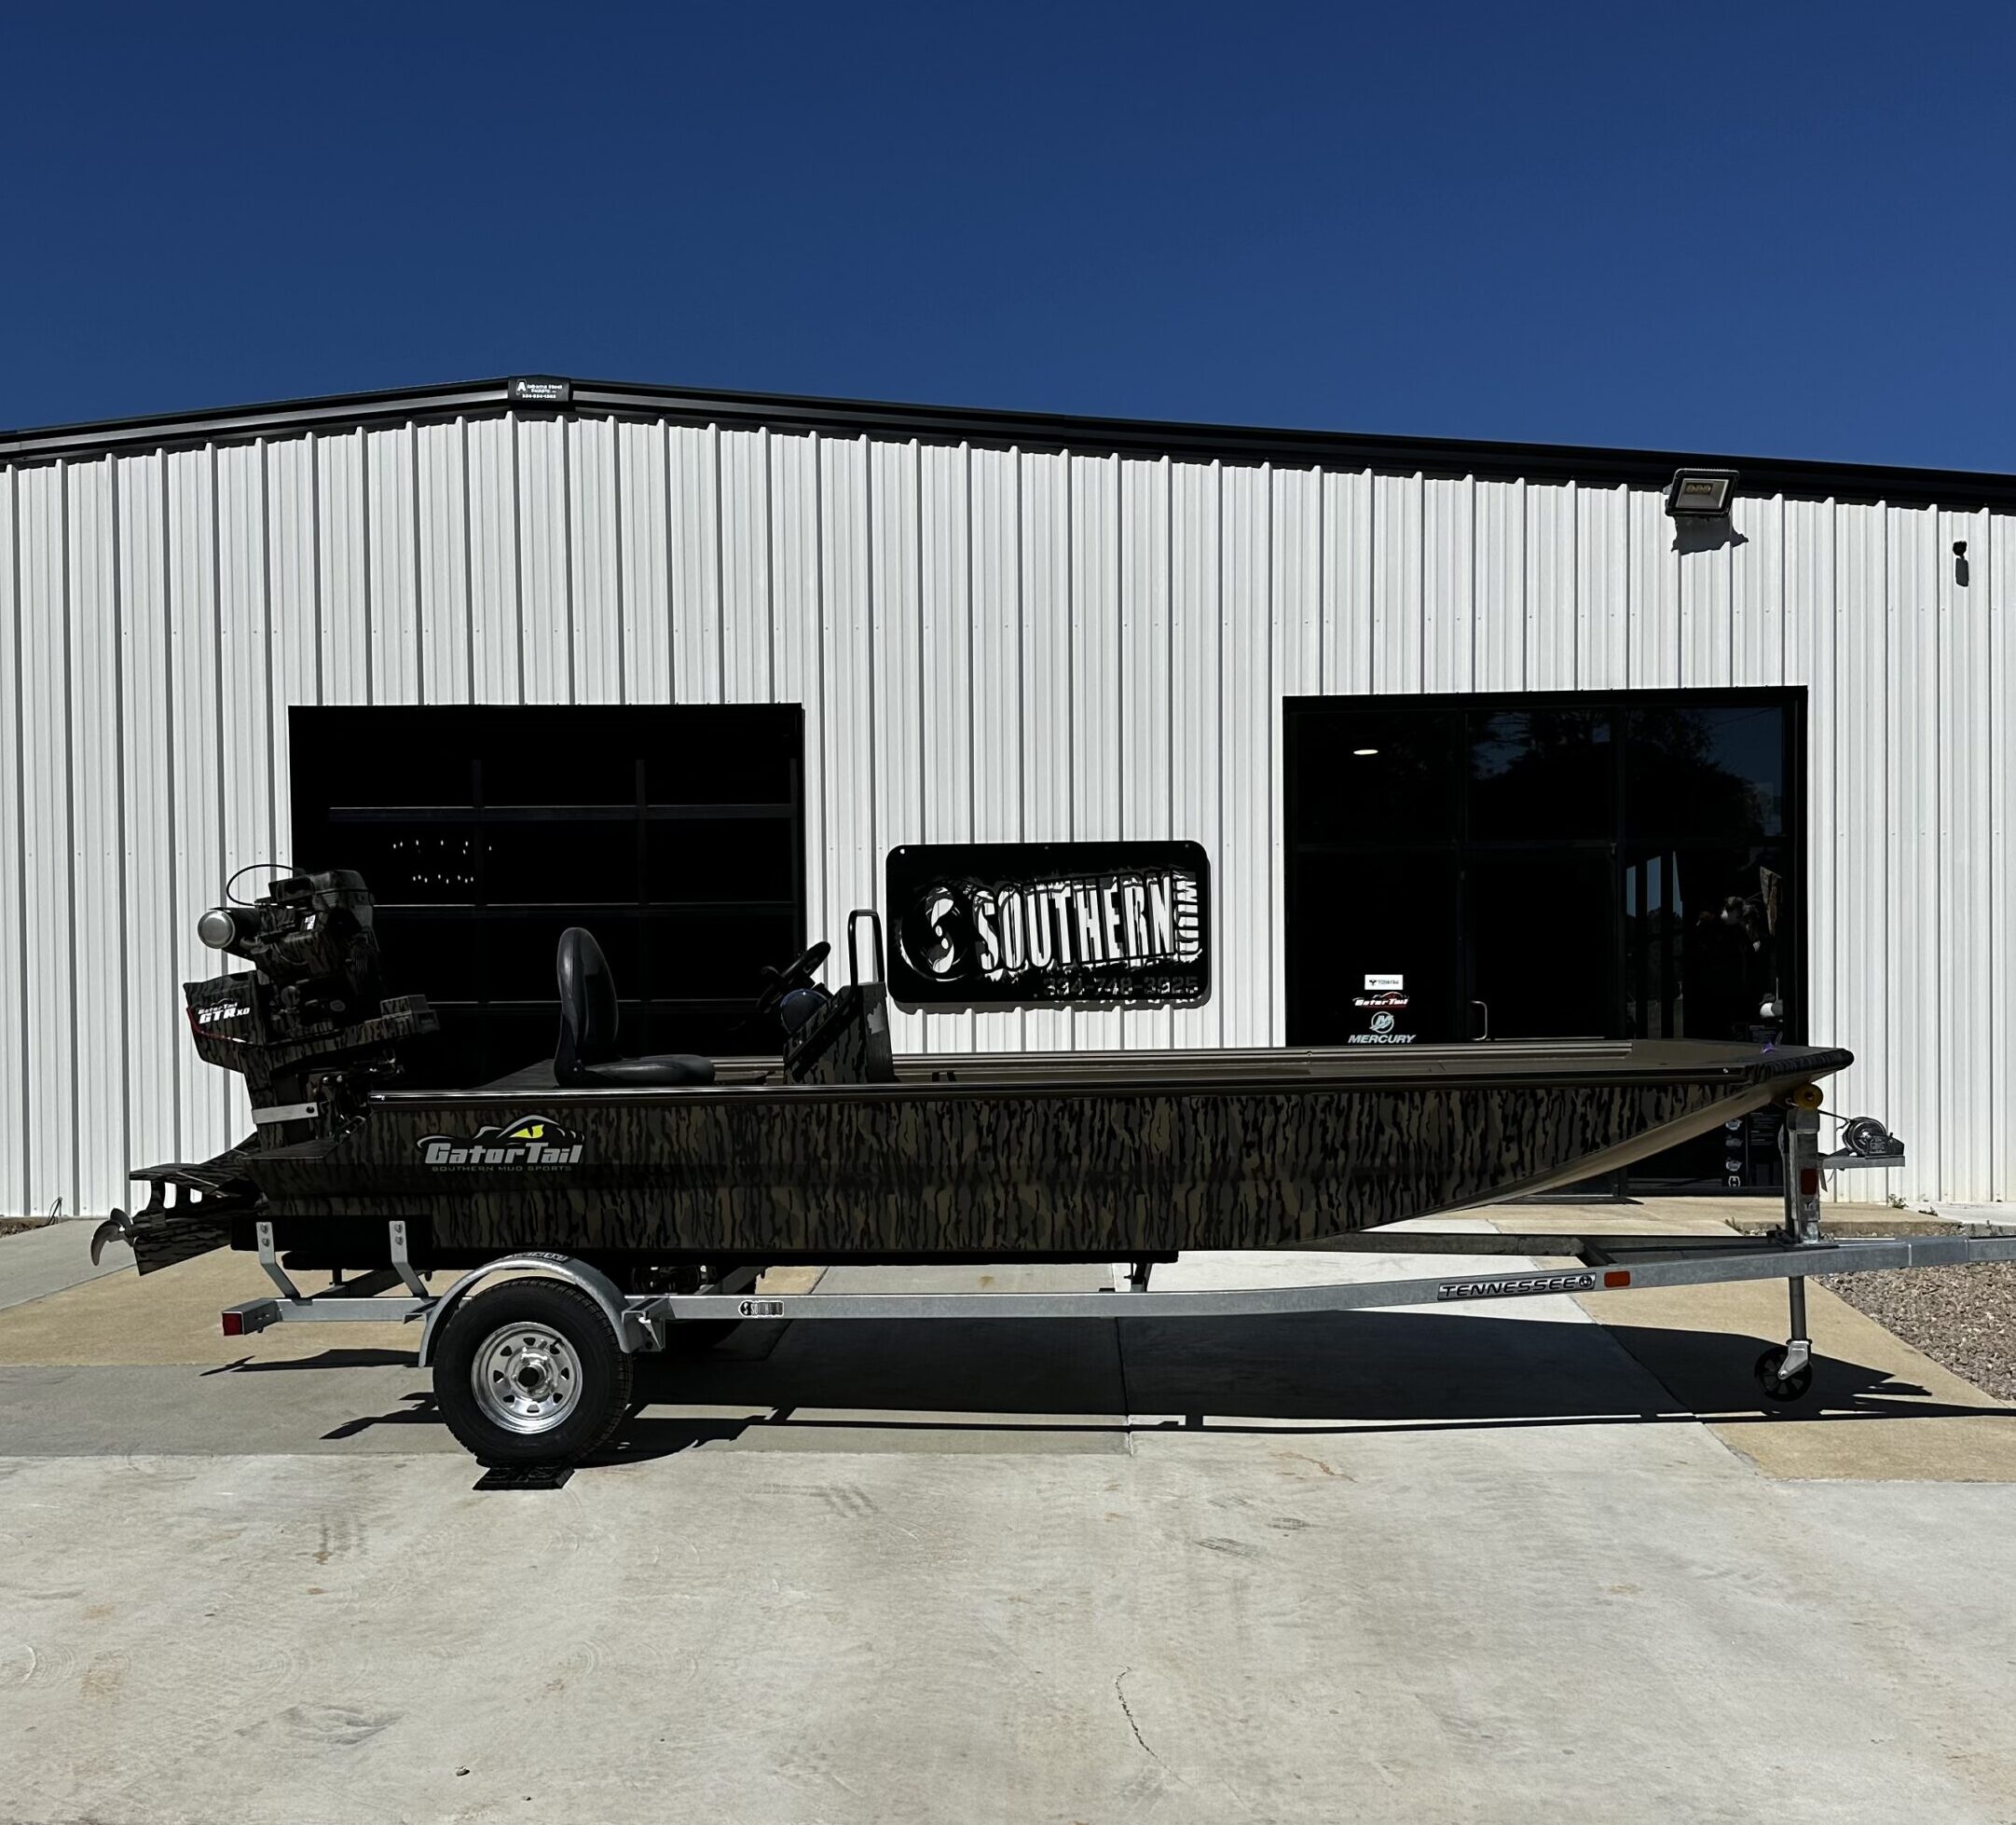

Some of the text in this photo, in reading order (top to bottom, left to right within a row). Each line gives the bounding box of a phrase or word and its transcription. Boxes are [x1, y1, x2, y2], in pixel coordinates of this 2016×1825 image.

[973, 871, 1173, 971] SOUTHERN
[1348, 1035, 1417, 1044] MERCURY
[424, 1142, 583, 1164] GatorTail
[1442, 1276, 1577, 1297] TENNESSEE
